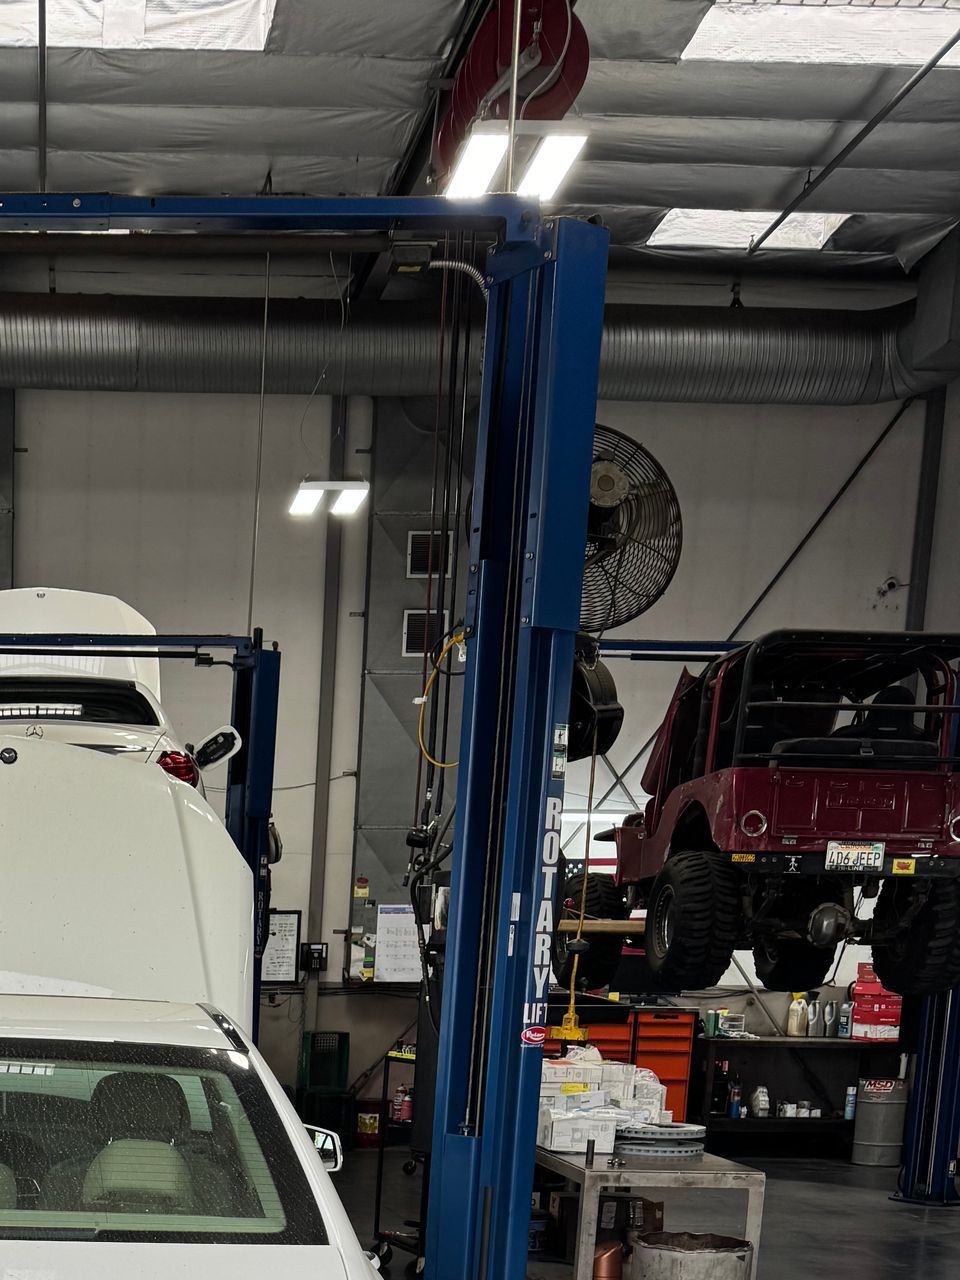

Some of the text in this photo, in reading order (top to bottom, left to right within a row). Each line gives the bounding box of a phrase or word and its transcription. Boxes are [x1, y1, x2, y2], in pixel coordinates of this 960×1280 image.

[852, 852, 881, 867] JEEP
[533, 797, 563, 999] ROTARY
[866, 1079, 894, 1089] MSD
